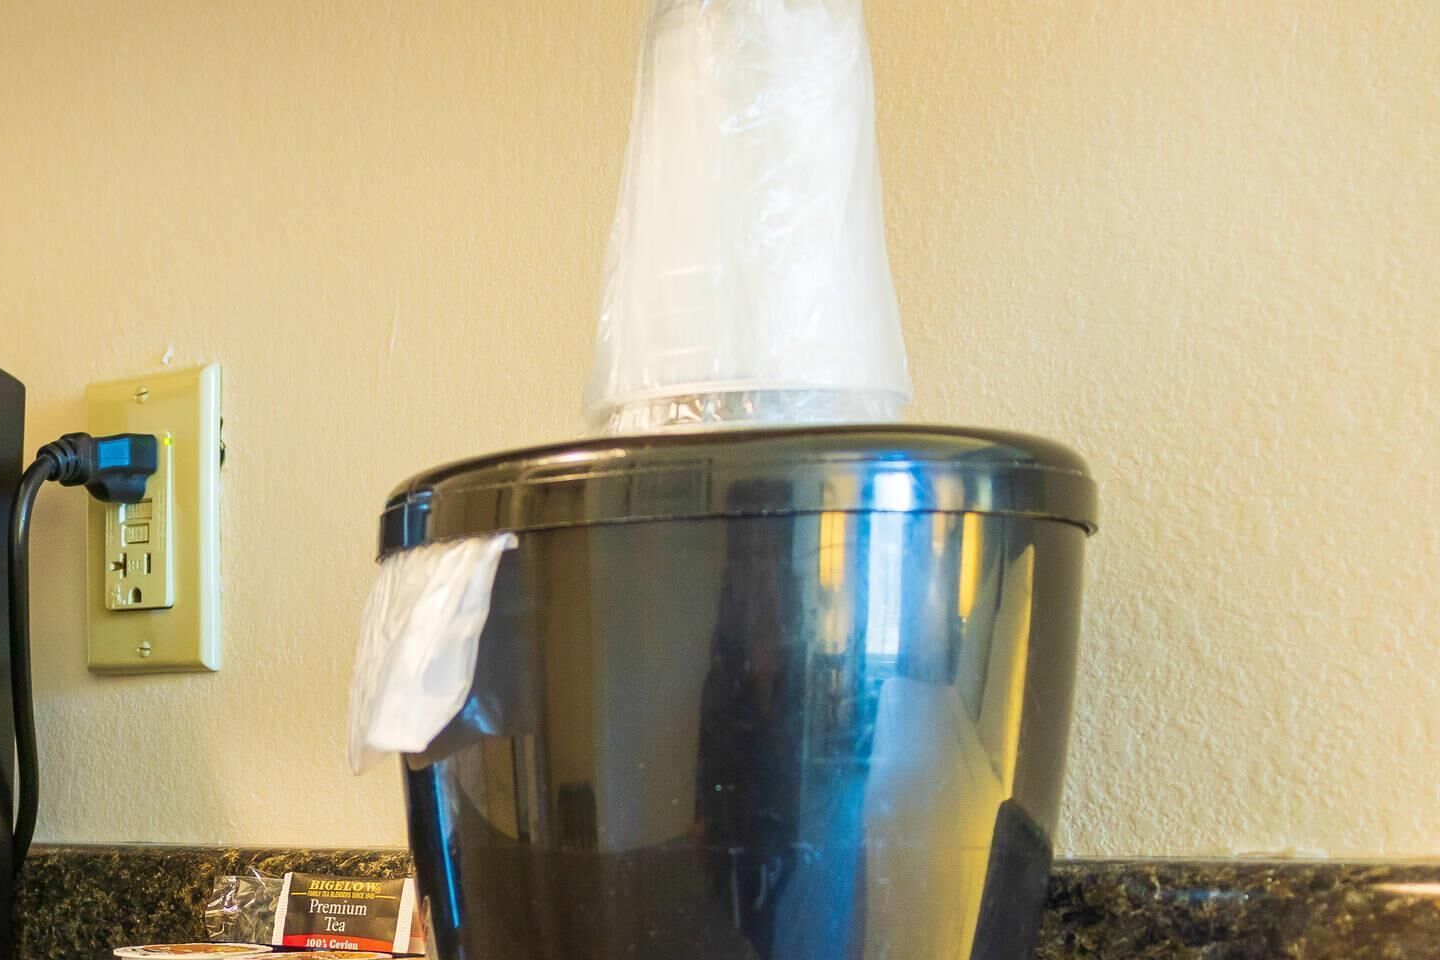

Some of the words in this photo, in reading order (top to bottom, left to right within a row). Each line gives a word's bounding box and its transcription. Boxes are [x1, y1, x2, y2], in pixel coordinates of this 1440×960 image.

[309, 880, 381, 892] BIGELOW
[309, 898, 367, 916] Premium
[324, 916, 346, 932] Tea
[305, 938, 328, 949] 100%
[329, 939, 359, 950] Ceylon
